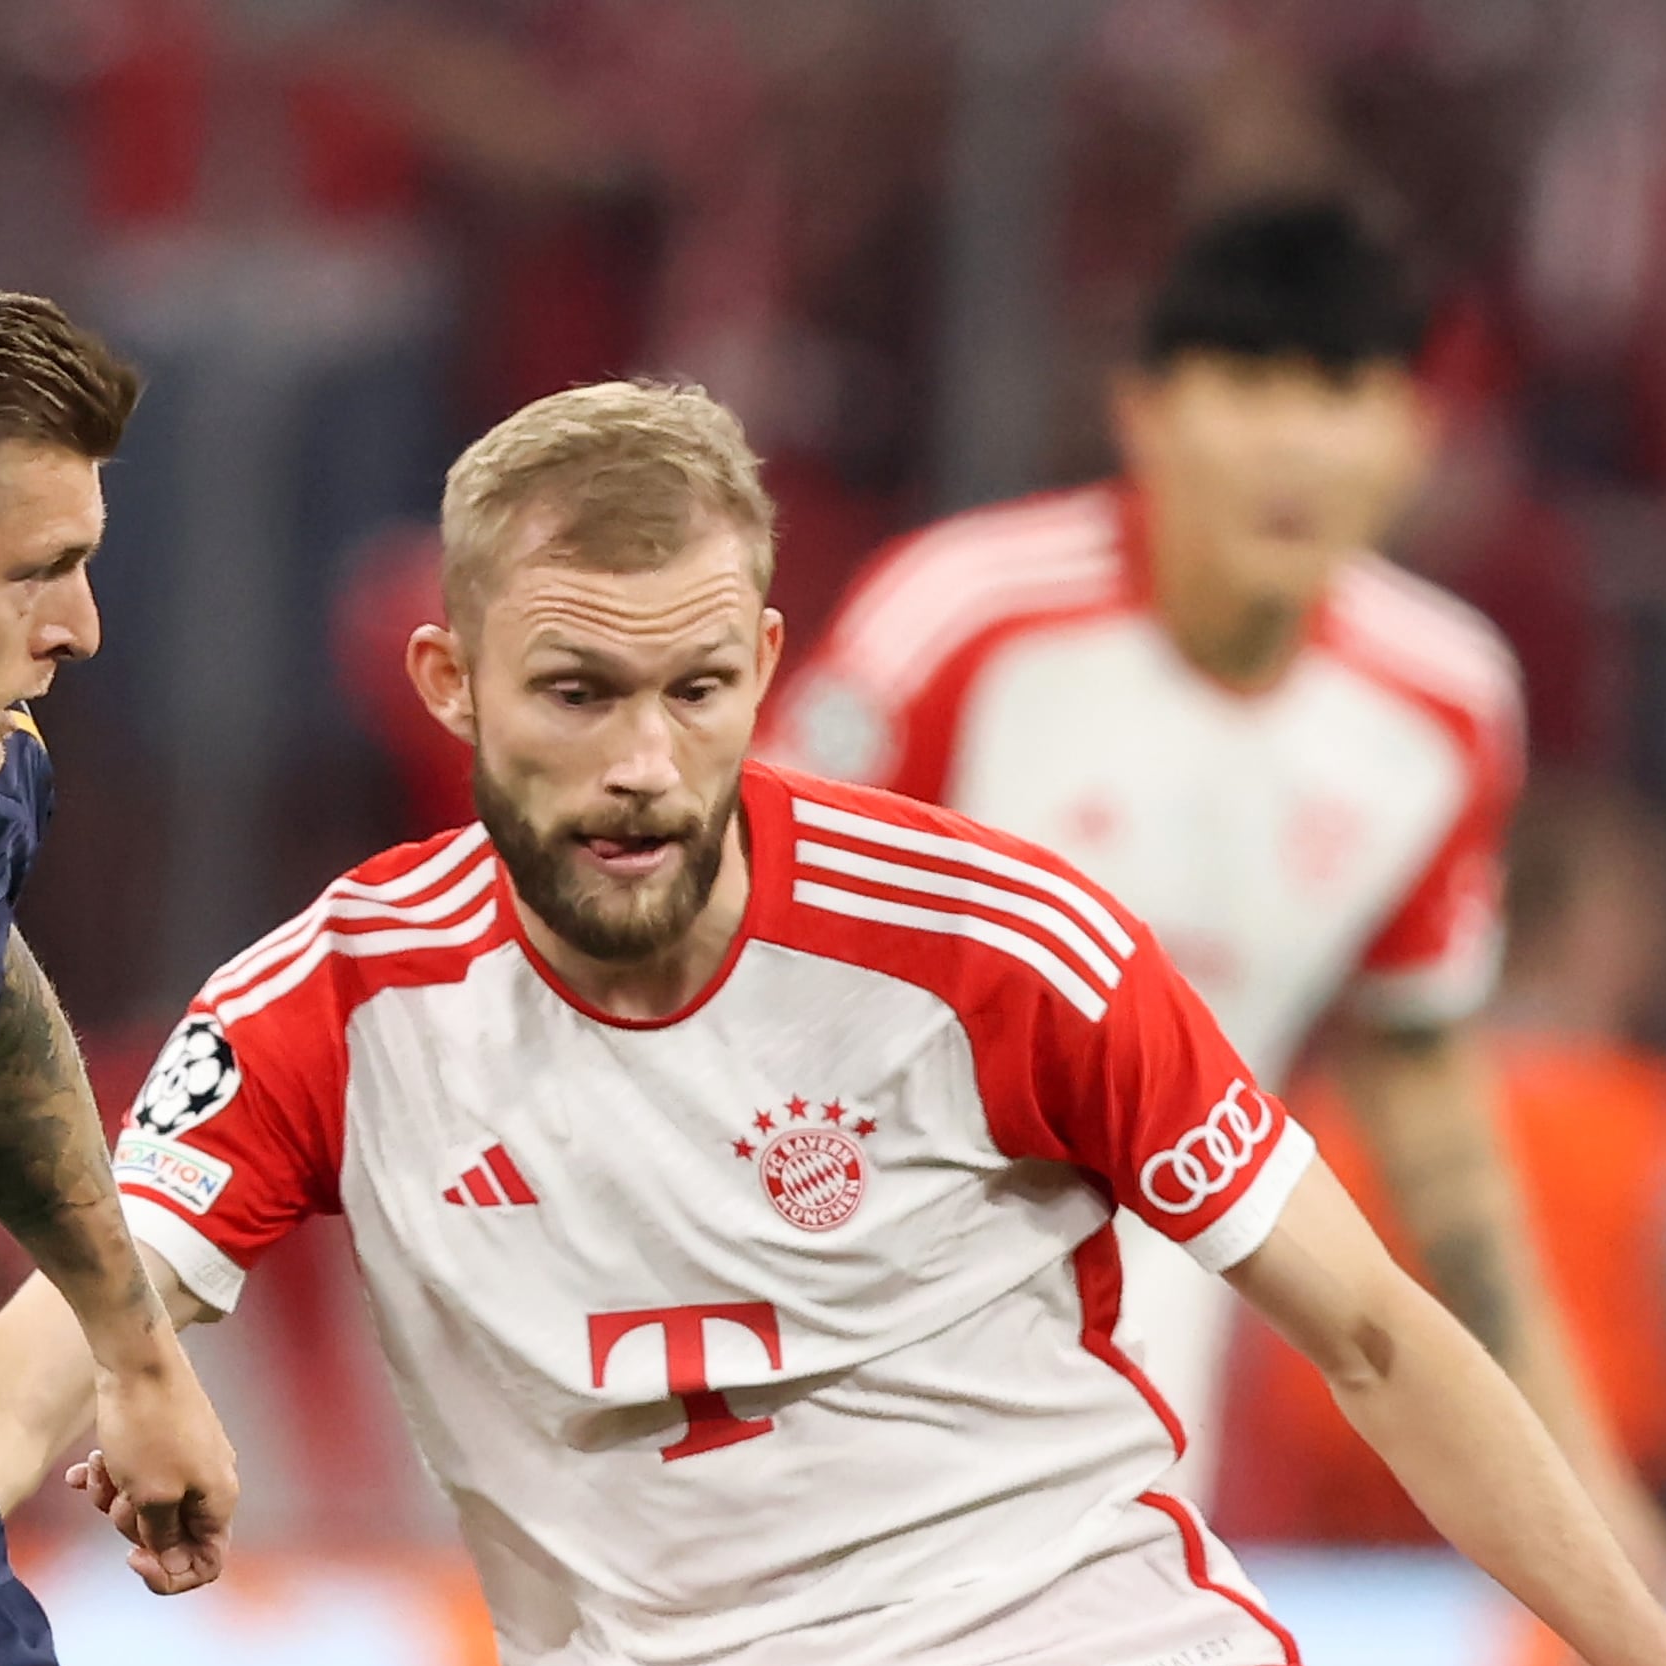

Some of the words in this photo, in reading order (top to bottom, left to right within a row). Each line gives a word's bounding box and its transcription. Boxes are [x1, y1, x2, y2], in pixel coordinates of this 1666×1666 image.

[116, 1148, 218, 1196] DATION
[766, 1150, 787, 1178] FC
[779, 1134, 854, 1165] BAYERN
[586, 1301, 783, 1464] T
